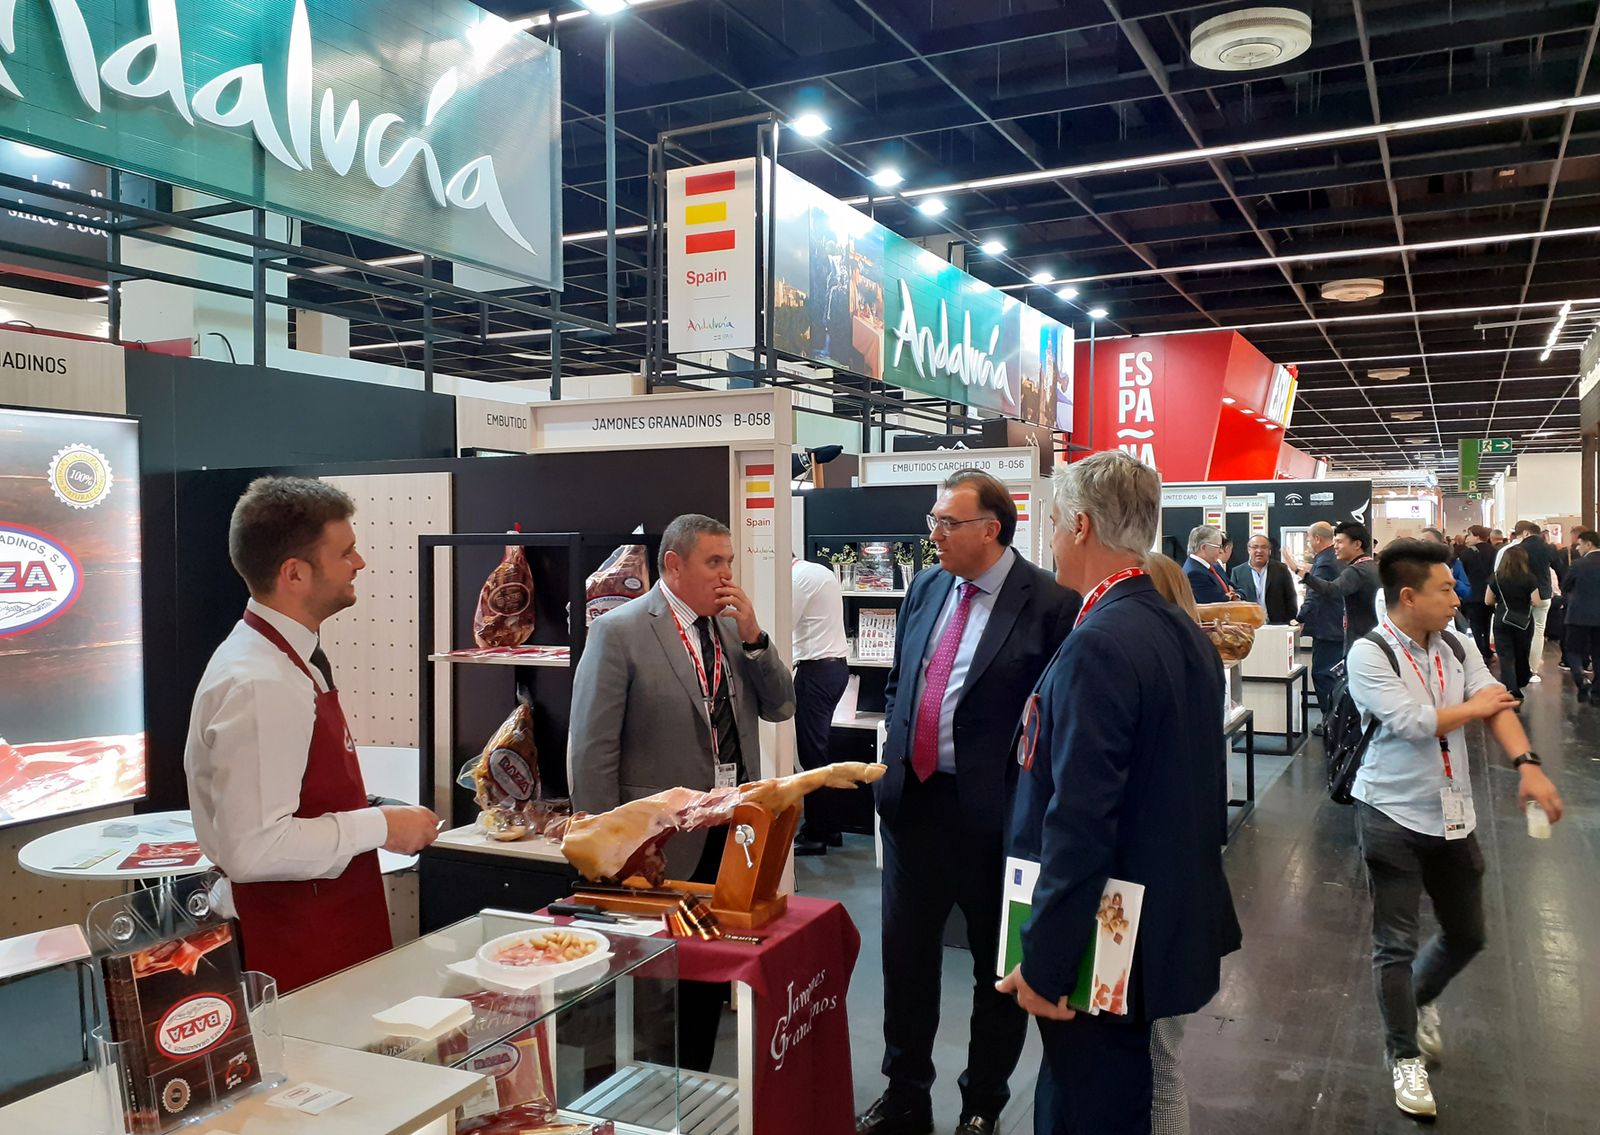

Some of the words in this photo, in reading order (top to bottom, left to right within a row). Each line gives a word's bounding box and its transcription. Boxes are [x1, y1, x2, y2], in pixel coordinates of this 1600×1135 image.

[0, 0, 538, 256] ndalucía
[686, 268, 728, 287] Spain
[892, 278, 1015, 405] Andalucía
[0, 352, 66, 375] ADINOS
[1119, 352, 1153, 388] ES
[1118, 387, 1155, 424] PA
[592, 416, 646, 431] JAMONES
[648, 414, 723, 430] GRANADINOS
[733, 413, 771, 427] B-058
[70, 469, 93, 486] 100%
[892, 464, 937, 473] EMBUTIDOS
[998, 460, 1025, 469] B-056
[1469, 480, 1478, 491] B
[746, 518, 771, 526] Spain
[499, 755, 530, 795] BAZA
[166, 1010, 221, 1043] BAZA
